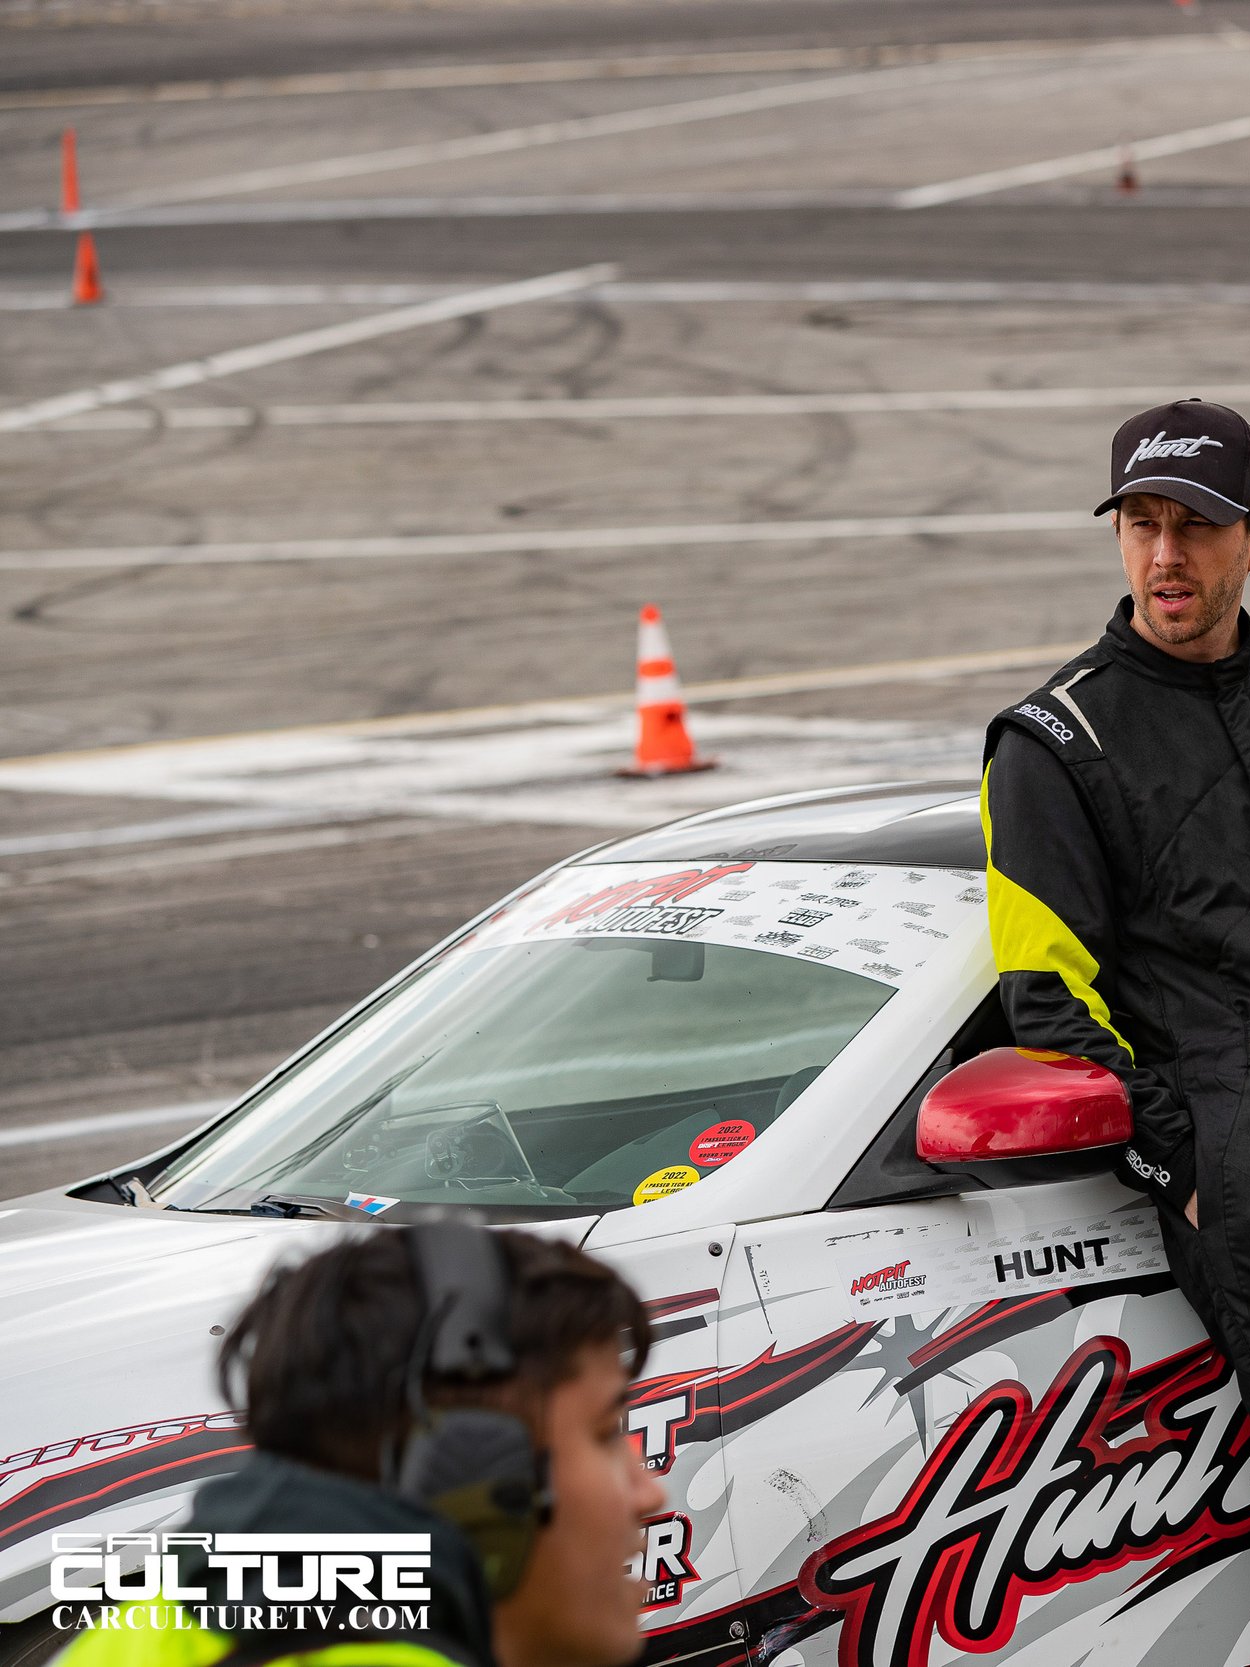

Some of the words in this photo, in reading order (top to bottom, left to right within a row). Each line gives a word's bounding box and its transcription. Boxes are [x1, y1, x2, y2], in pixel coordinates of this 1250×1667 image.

[1125, 431, 1223, 474] Hunt
[1016, 703, 1074, 744] sparco
[575, 905, 725, 935] AUTOFEST
[717, 1126, 743, 1135] 2022
[662, 1171, 687, 1180] 2022
[993, 1237, 1110, 1283] HUNT
[850, 1259, 911, 1297] HOTPIT
[879, 1274, 927, 1293] AUTOFEST
